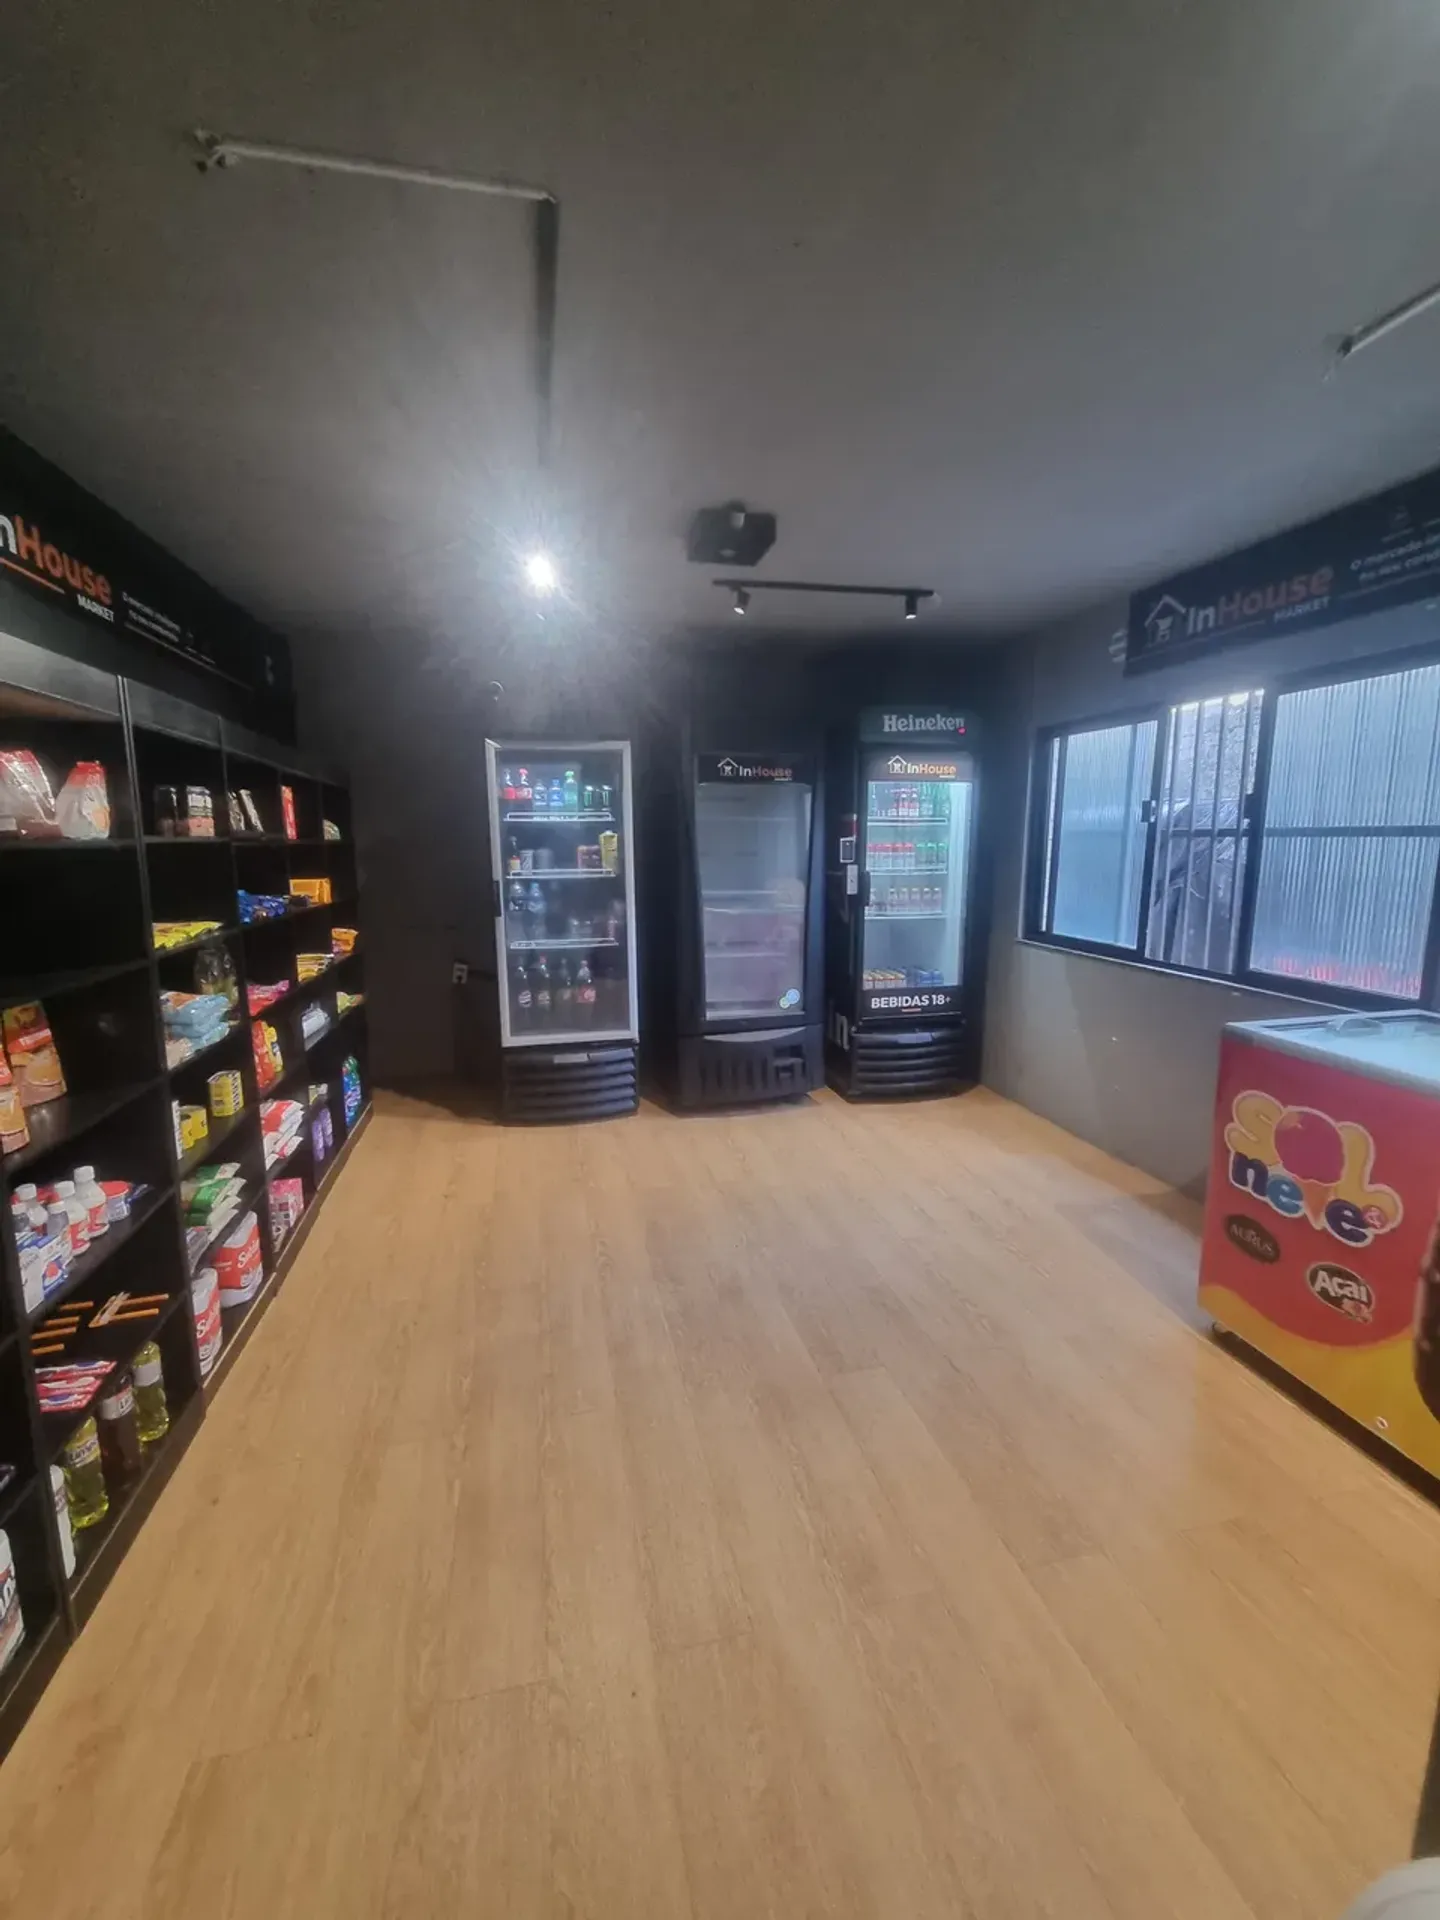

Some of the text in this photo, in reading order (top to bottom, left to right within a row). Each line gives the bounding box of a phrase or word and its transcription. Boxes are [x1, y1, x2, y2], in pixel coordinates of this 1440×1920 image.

[1187, 566, 1334, 635] InHouse
[1273, 596, 1330, 623] MARKET
[882, 713, 965, 733] Heineken
[739, 765, 793, 777] InHouse
[907, 763, 956, 775] InHouse
[871, 994, 951, 1009] BEBIDAS 18+
